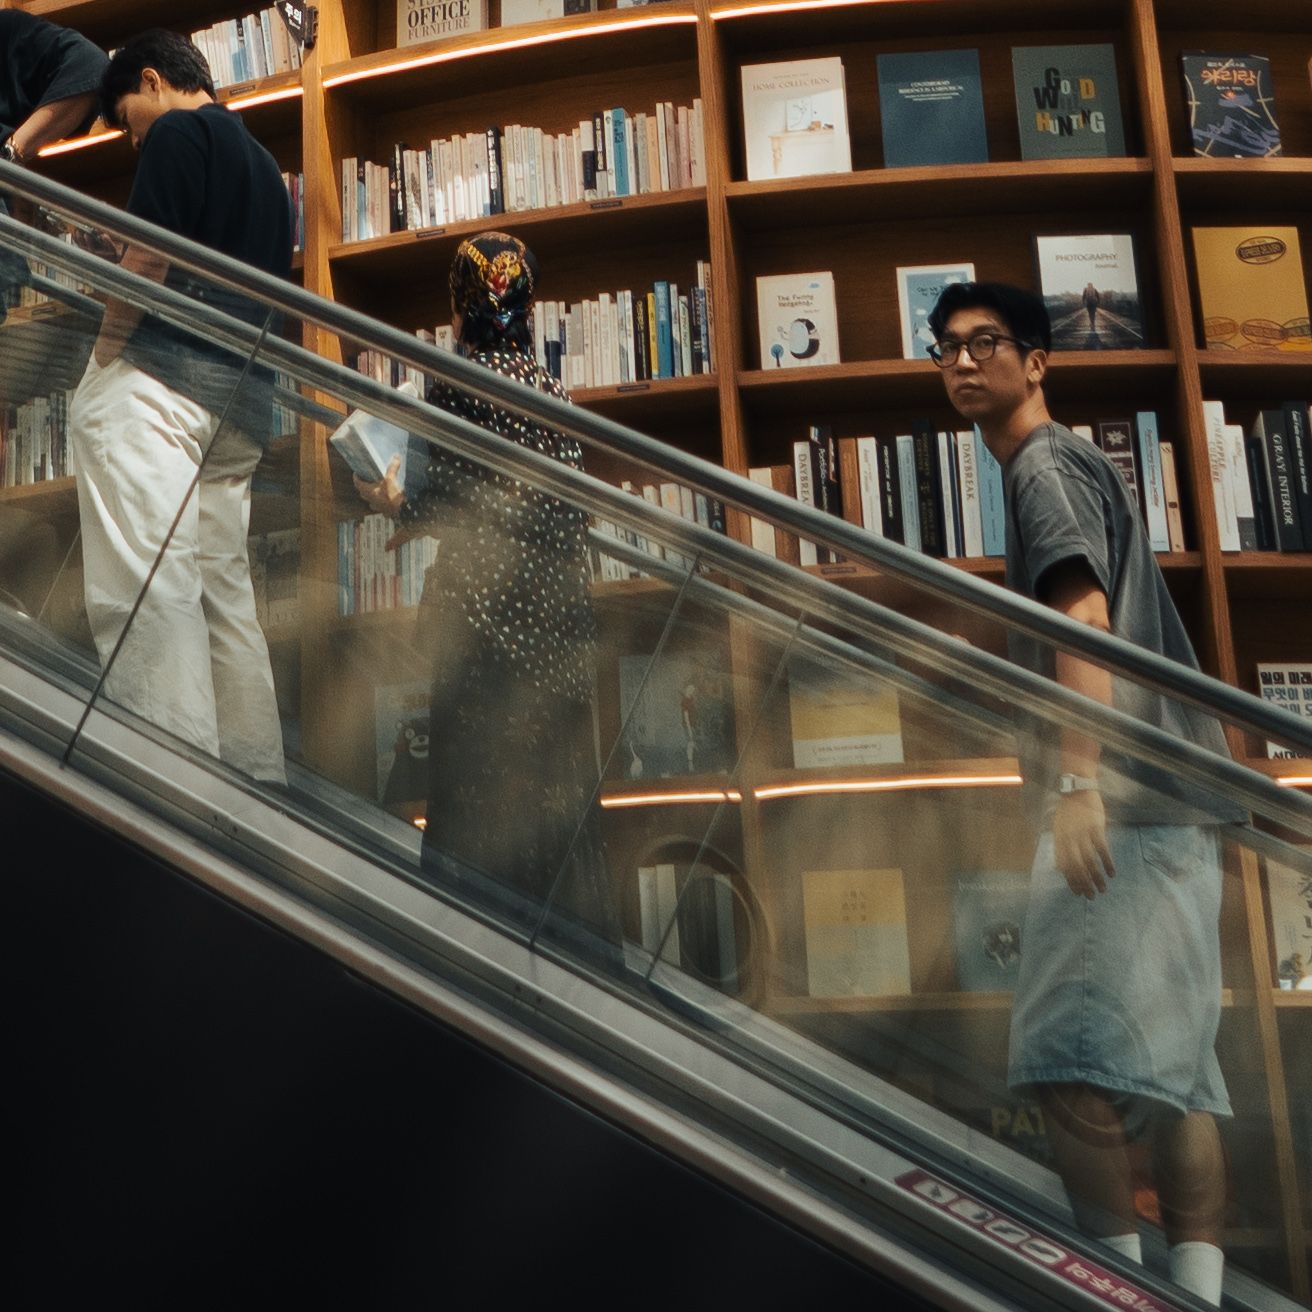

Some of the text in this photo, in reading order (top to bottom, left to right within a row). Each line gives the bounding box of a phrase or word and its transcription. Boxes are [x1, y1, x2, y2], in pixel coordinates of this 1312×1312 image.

[284, 2, 302, 24] 주의
[407, 16, 470, 41] FURNITURE
[752, 77, 830, 92] HOME COLLECTION
[1201, 68, 1257, 86] 아리랑
[1036, 107, 1106, 137] HUNTING
[1055, 252, 1119, 263] PHOTOGRAPHY
[777, 294, 789, 302] The
[798, 453, 809, 504] DAYBREA
[962, 443, 975, 501] DAYBREAK
[1273, 433, 1293, 525] GRAY INTERIOR
[1260, 671, 1286, 685] 일의
[1262, 687, 1299, 701] 무엇이
